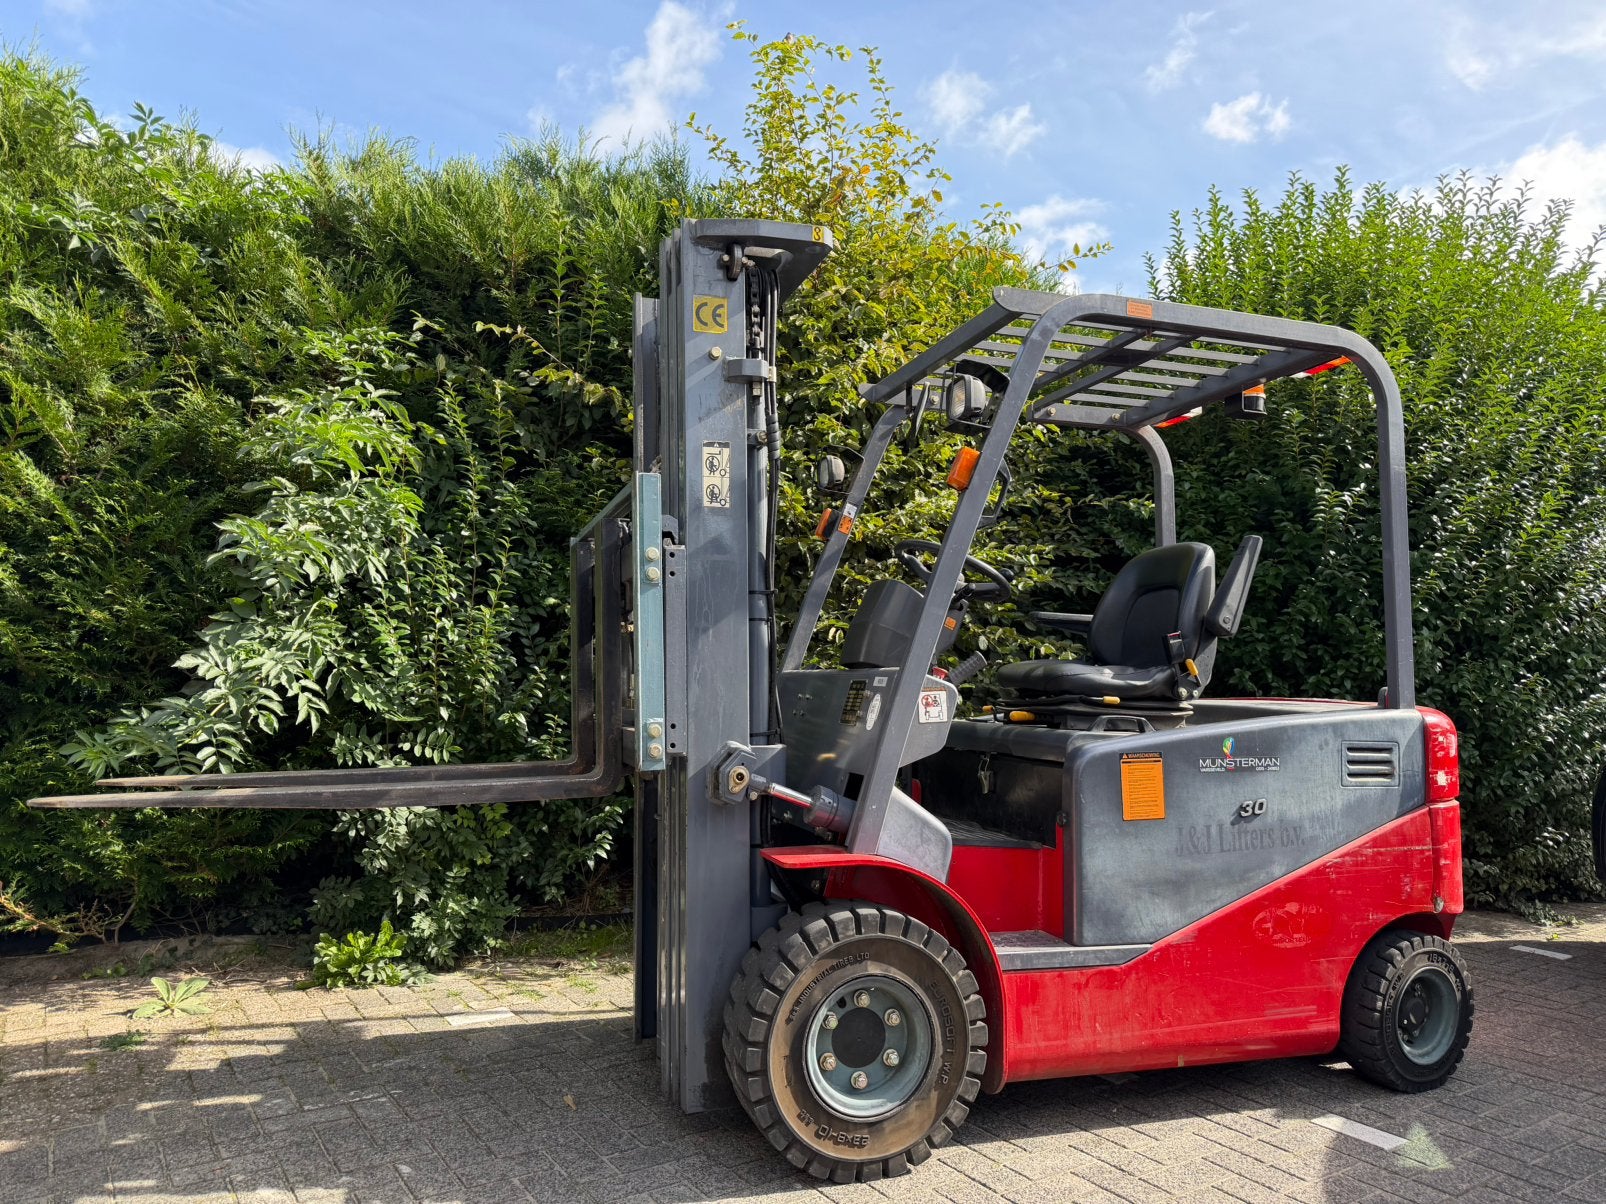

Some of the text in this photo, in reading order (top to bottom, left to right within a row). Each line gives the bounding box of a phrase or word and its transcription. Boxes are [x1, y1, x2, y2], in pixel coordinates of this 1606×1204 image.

[695, 302, 725, 328] CE
[1199, 757, 1280, 768] MUNSTERMAN
[1240, 798, 1266, 817] 30
[1217, 820, 1275, 853] Lifters
[928, 981, 956, 1054] EUROSOFT
